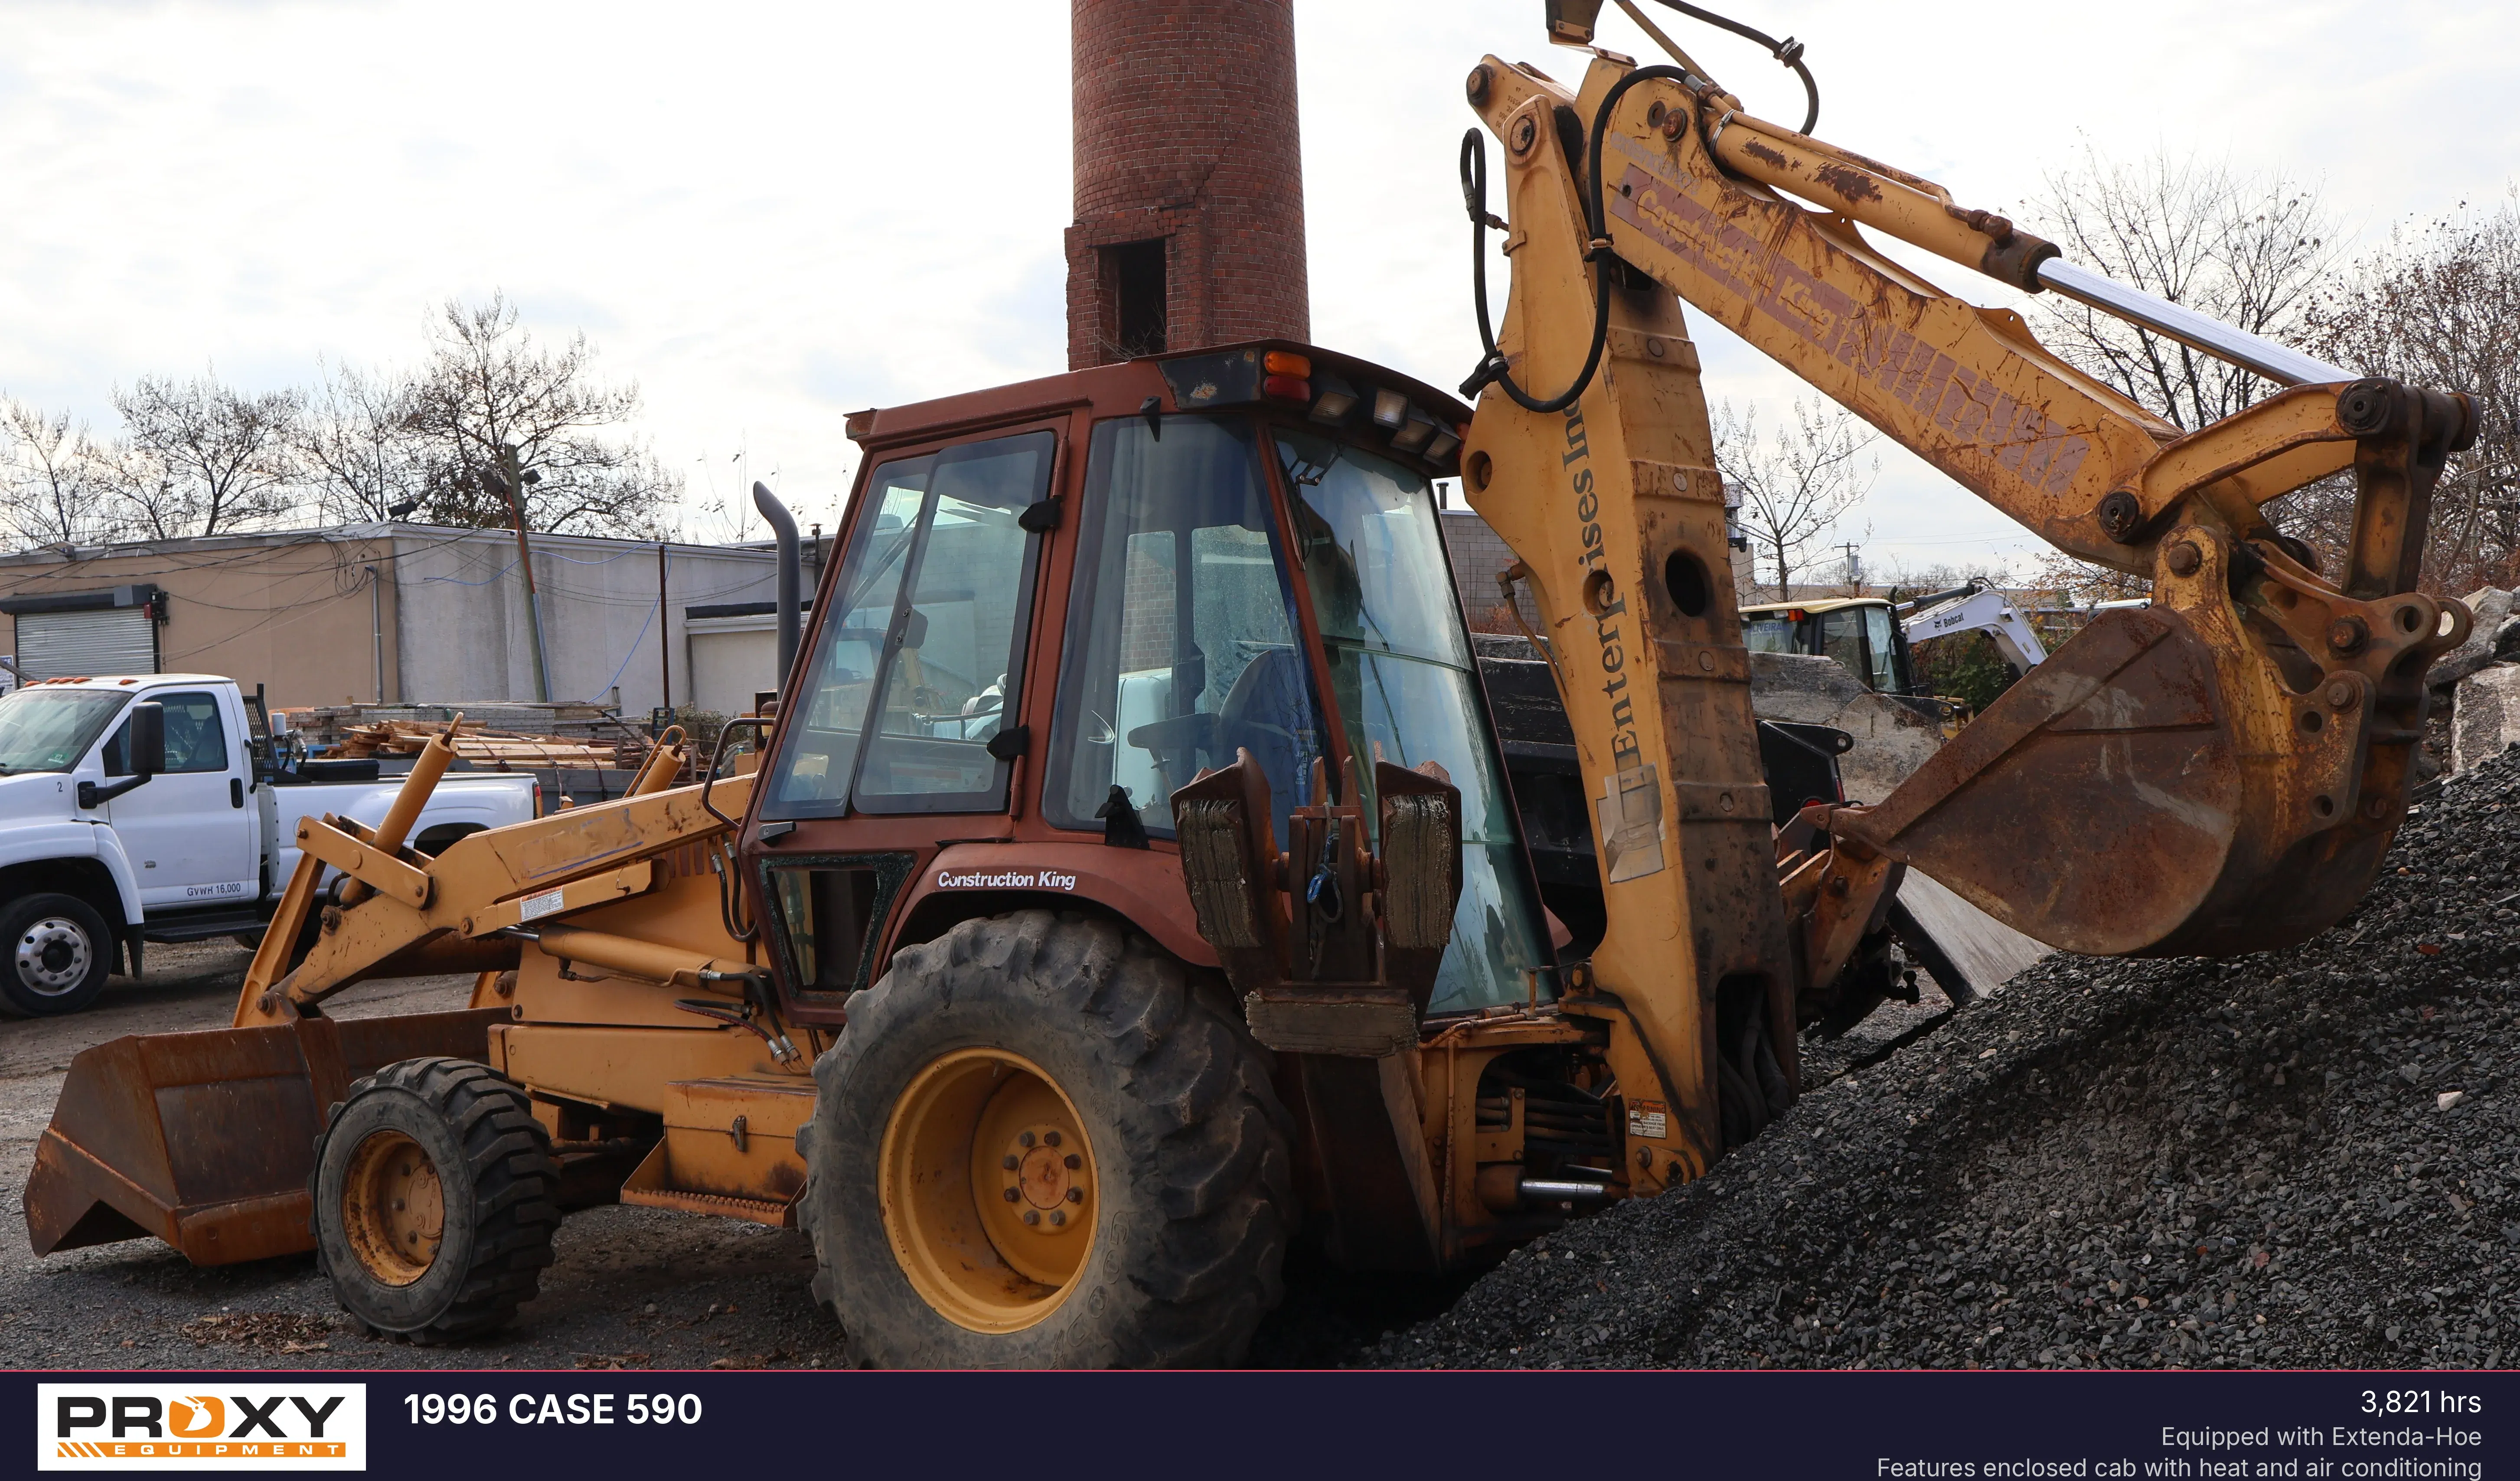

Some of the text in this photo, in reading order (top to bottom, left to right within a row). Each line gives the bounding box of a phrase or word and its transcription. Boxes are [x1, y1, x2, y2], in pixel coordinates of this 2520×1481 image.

[1778, 276, 1837, 341] King
[1573, 468, 1641, 759] Enterises
[1943, 612, 1965, 628] Bobcat
[57, 781, 63, 793] 2
[215, 883, 241, 895] 16,000
[938, 871, 1076, 891] Construction King
